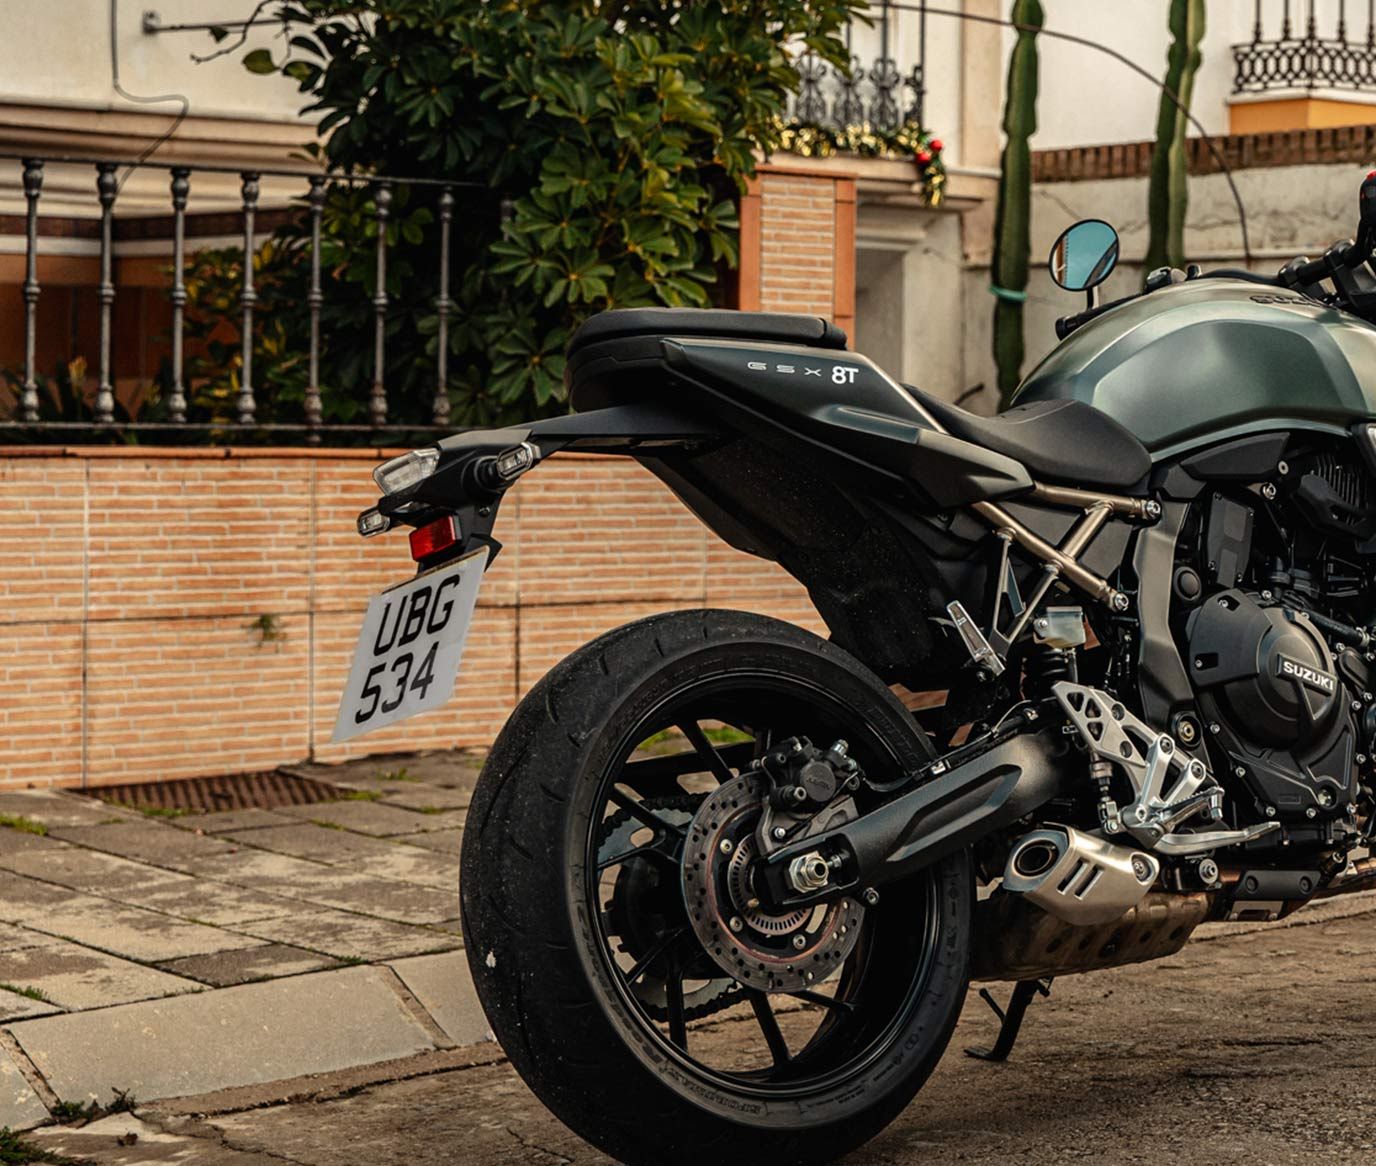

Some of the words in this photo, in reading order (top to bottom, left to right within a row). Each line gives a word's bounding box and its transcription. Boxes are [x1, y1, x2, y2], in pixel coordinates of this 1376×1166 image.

[831, 365, 859, 385] 8T
[373, 574, 460, 657] UBG
[354, 641, 440, 724] 534
[1283, 661, 1333, 690] SUZUKI
